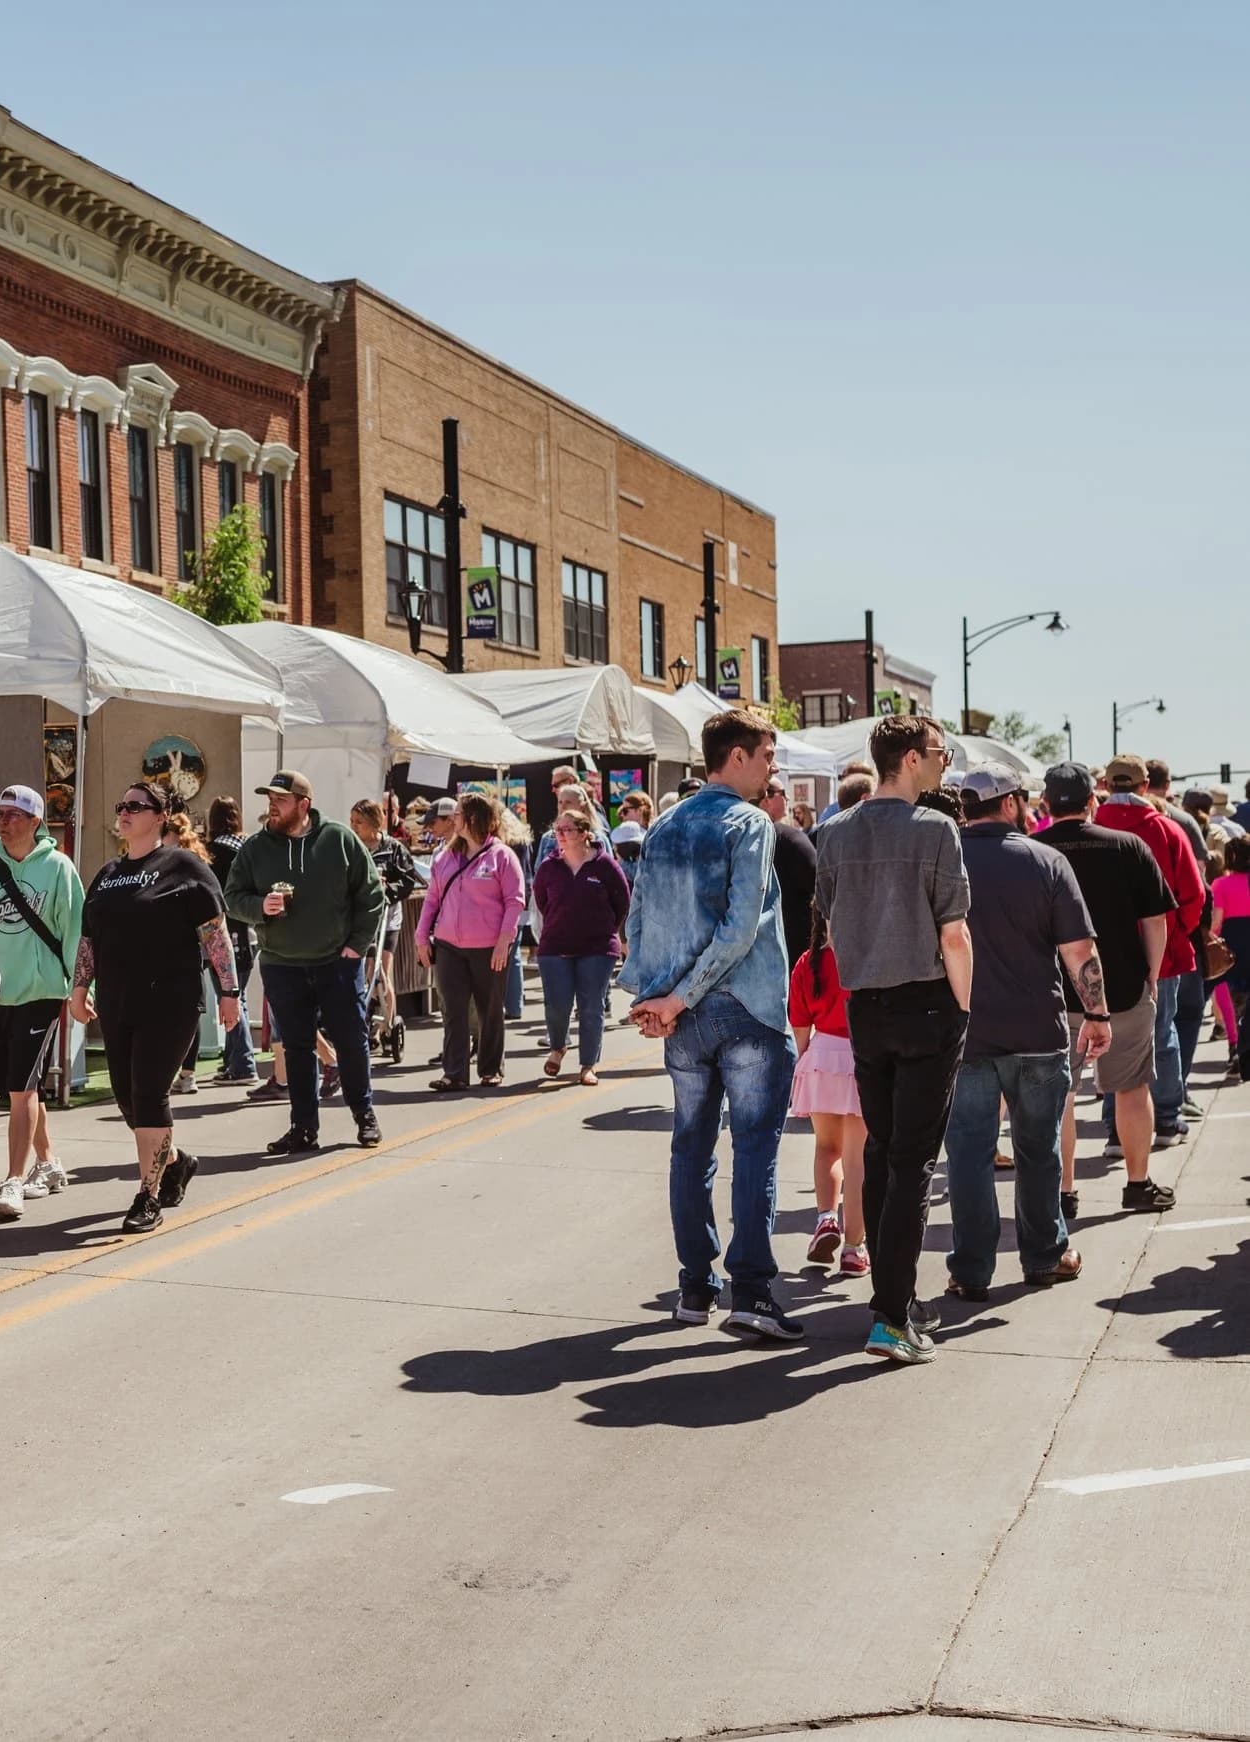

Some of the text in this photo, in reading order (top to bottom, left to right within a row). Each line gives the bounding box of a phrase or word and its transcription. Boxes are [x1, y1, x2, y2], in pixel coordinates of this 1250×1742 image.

[473, 587, 492, 609] M
[723, 663, 737, 679] M
[97, 870, 160, 891] Seriously?
[754, 1301, 773, 1312] FILA
